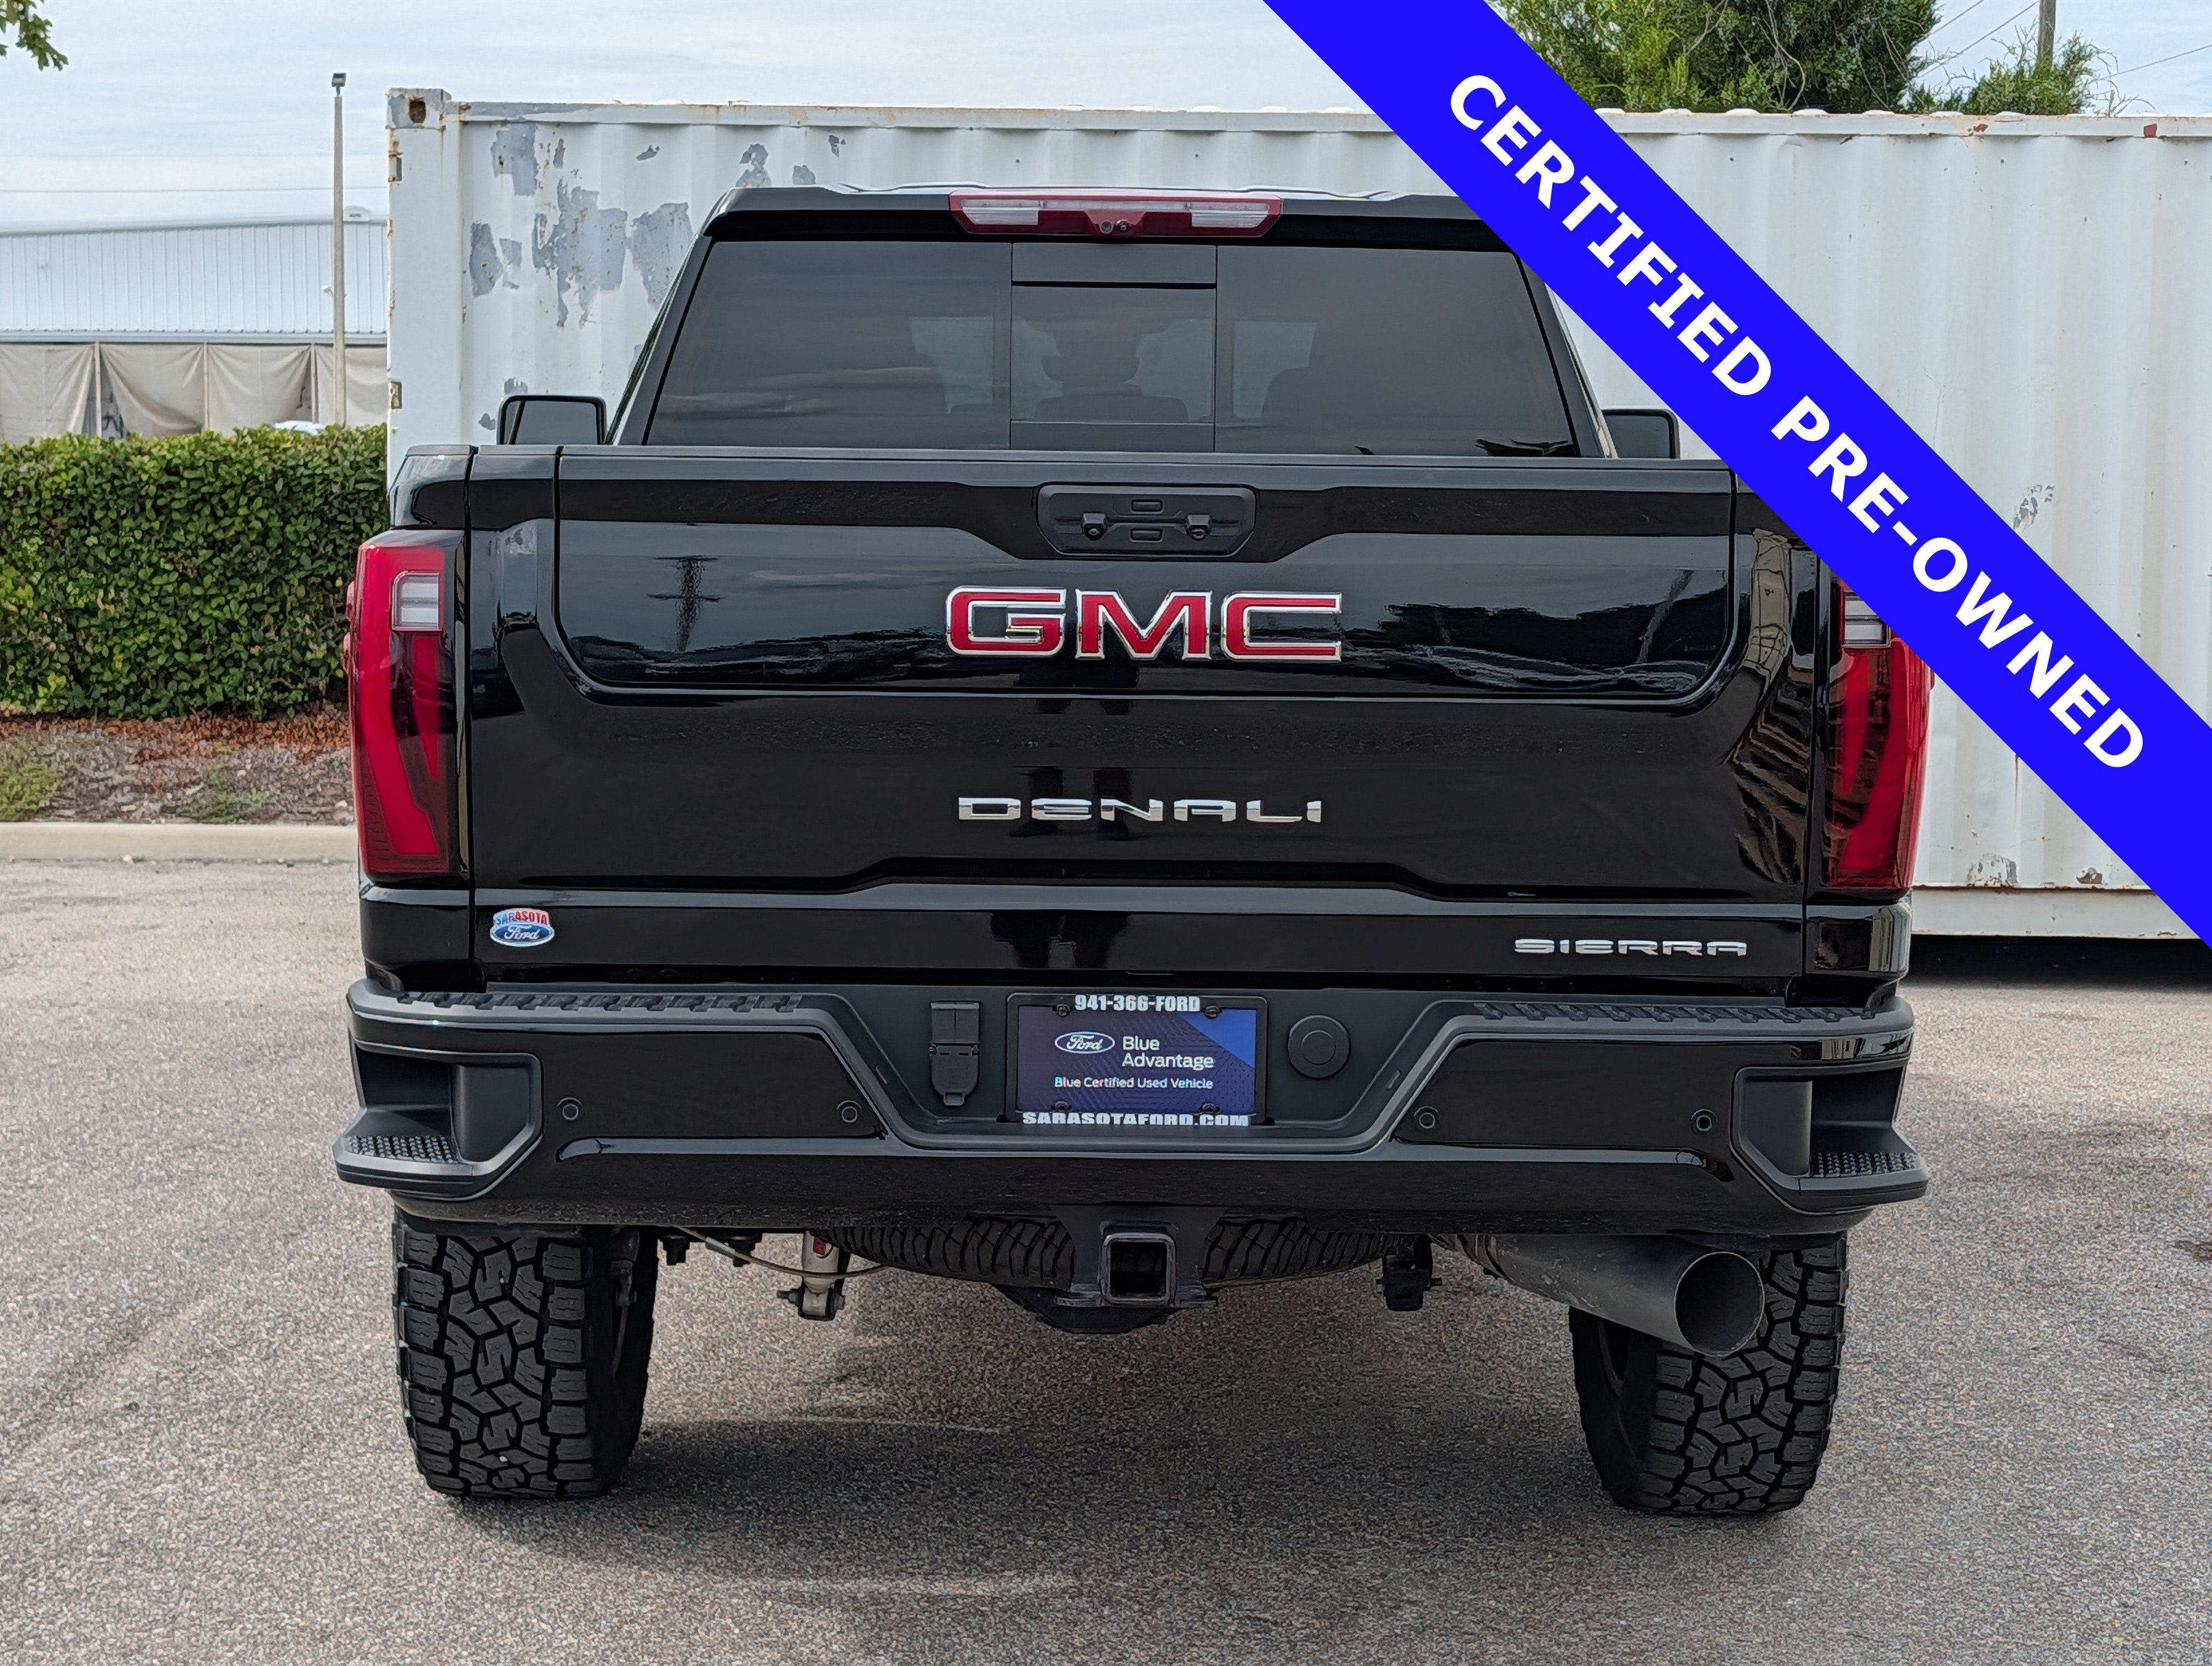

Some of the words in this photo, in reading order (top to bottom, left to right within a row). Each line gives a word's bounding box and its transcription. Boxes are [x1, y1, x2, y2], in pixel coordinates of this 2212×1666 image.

[946, 586, 1342, 663] GMC
[958, 797, 1322, 823] DENALI
[496, 911, 547, 925] SARASOTA
[504, 925, 540, 940] Ford
[1514, 938, 1747, 957] SIERRA
[1075, 995, 1200, 1012] 941-366-FORD
[1066, 1035, 1104, 1051] Ford
[1122, 1036, 1160, 1051] Blue
[1121, 1053, 1215, 1071] Advantage
[1054, 1077, 1081, 1088] Blue
[1084, 1077, 1134, 1088] Certified
[1137, 1078, 1167, 1089] Used
[1171, 1078, 1213, 1090] Vehicle
[1022, 1112, 1250, 1127] SARASOTAFORD.COM
